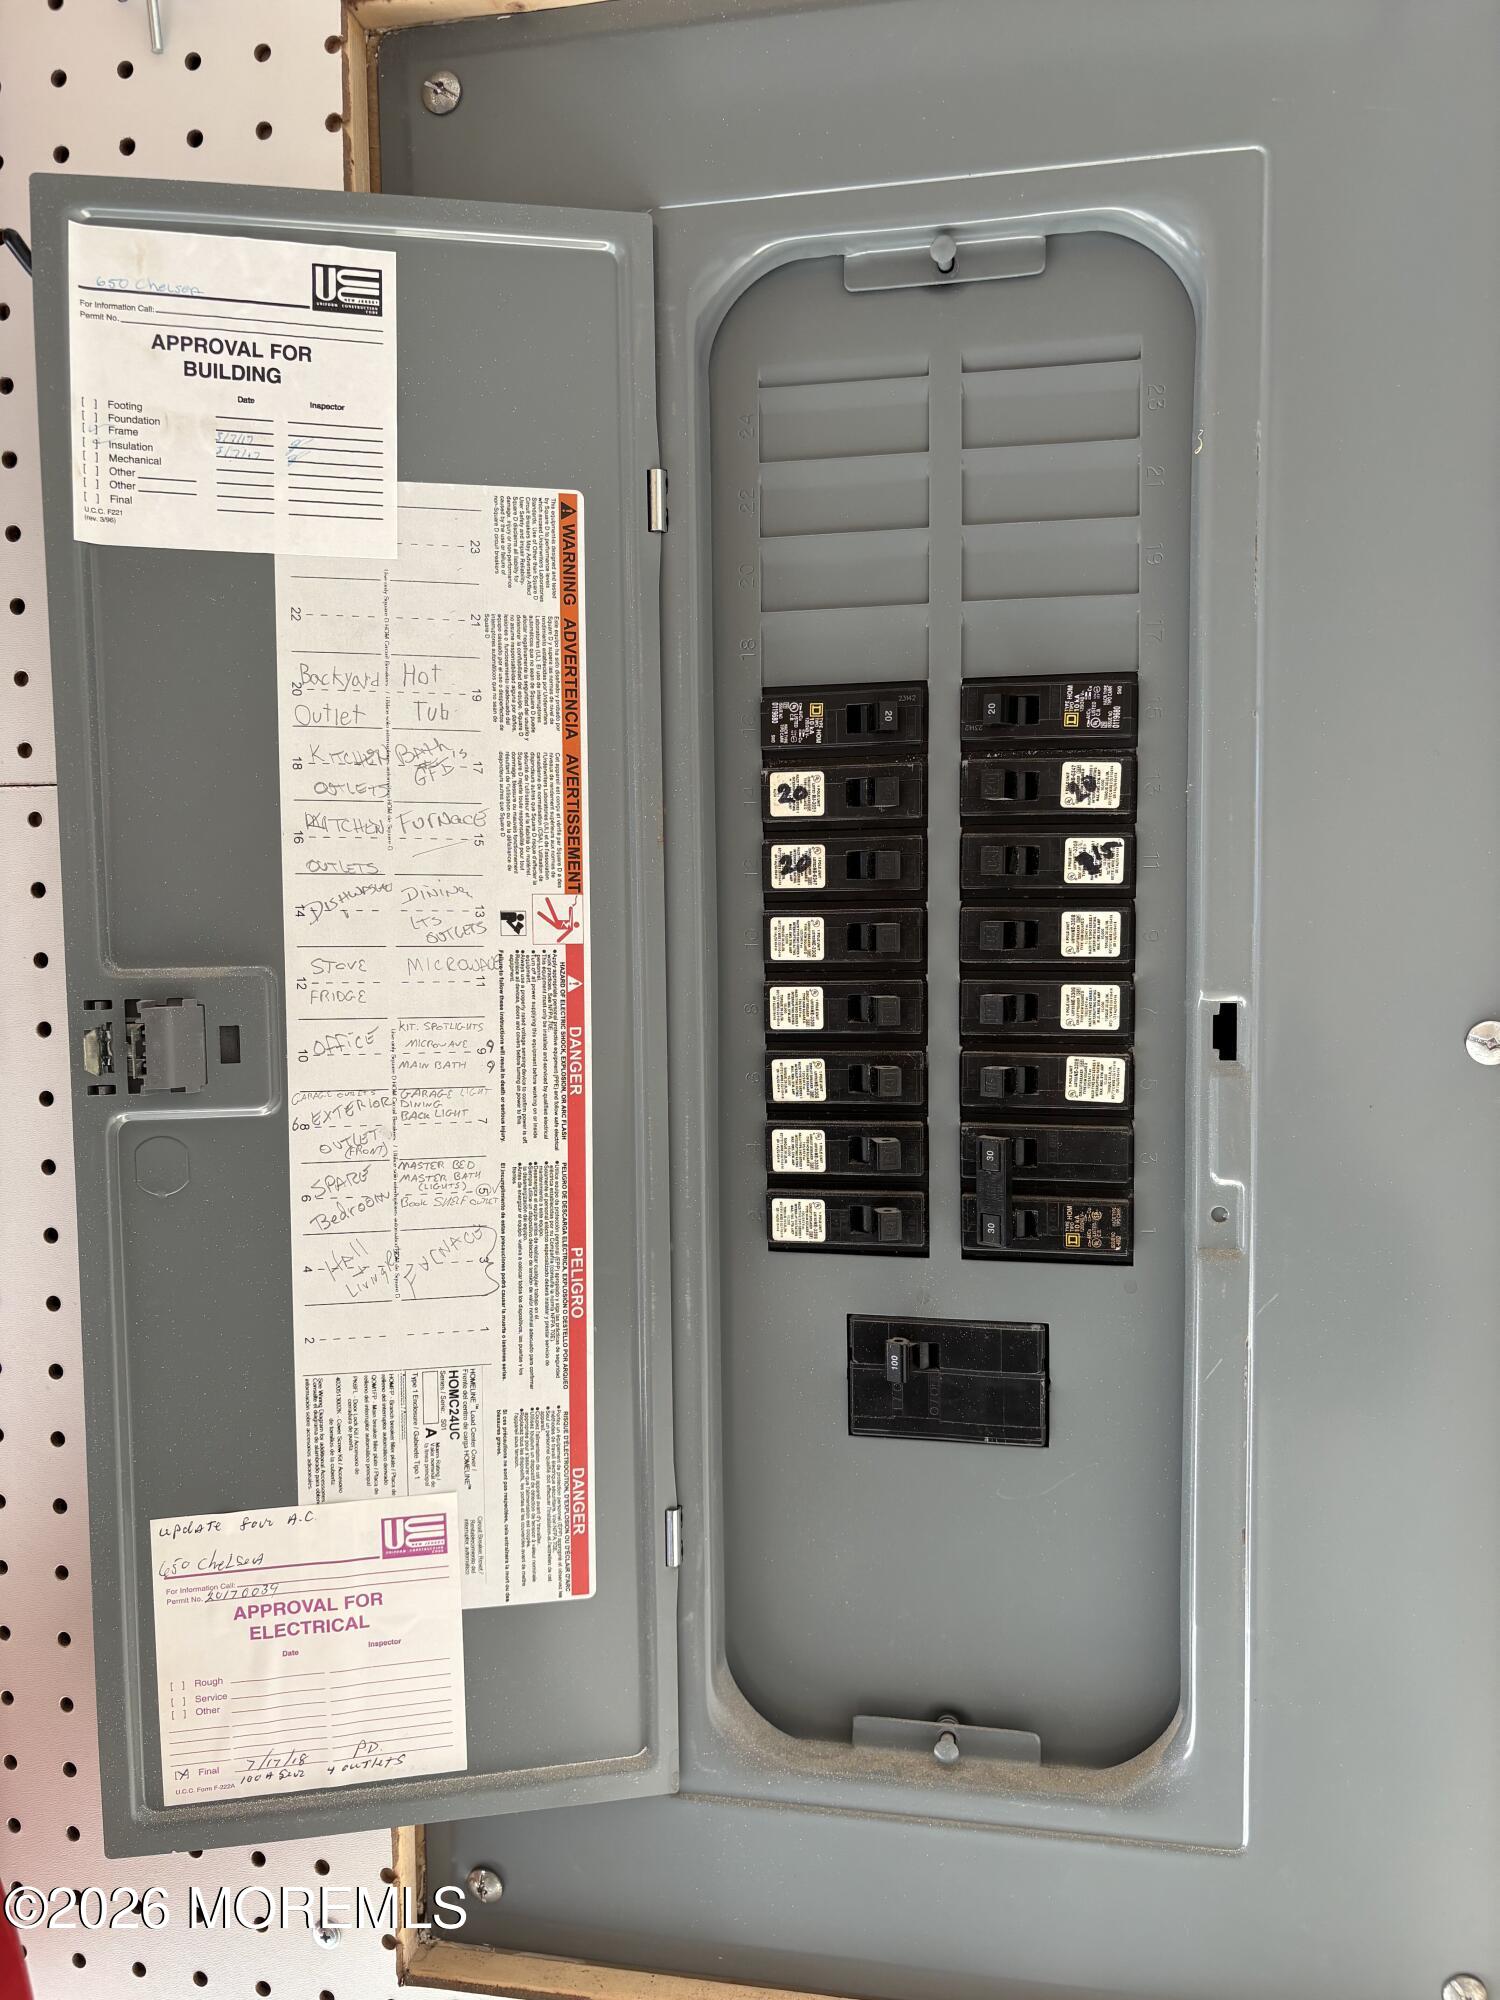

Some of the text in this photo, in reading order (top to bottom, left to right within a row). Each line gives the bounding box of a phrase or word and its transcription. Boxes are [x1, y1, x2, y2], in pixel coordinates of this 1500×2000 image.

[96, 276, 128, 288] 650
[80, 300, 155, 314] For Information Call:
[79, 311, 120, 323] Permit No.
[151, 334, 312, 363] APPROVAL FOR
[183, 361, 282, 385] BUILDING
[237, 396, 255, 405] Date
[1146, 383, 1166, 411] 23
[108, 400, 143, 413] Footing
[309, 402, 345, 412] Inspector
[108, 413, 161, 426] Foundation
[108, 426, 139, 437] Frame
[738, 413, 756, 441] 24
[108, 441, 154, 453] Insulation
[108, 454, 162, 466] Mechanical
[109, 467, 136, 477] Other
[1145, 466, 1166, 489] 21
[109, 480, 136, 491] Other
[109, 494, 133, 505] Final
[738, 487, 756, 514] 22
[84, 507, 123, 517] U.C.C. F221
[84, 514, 99, 524] (rev.
[470, 540, 480, 554] 23
[1145, 541, 1166, 566] 19
[562, 524, 577, 606] WARNING
[738, 564, 757, 589] 20
[290, 607, 301, 621] 22
[470, 614, 480, 626] 21
[1144, 618, 1166, 642] 17
[739, 637, 756, 660] 18
[299, 663, 380, 690] Backyard
[403, 663, 441, 687] Hot
[563, 618, 579, 740] ADVERTENCIA
[291, 681, 302, 696] 20
[472, 688, 482, 702] 19
[294, 703, 367, 726] Outlet
[413, 700, 449, 721] Tub
[987, 703, 996, 715] 20
[884, 710, 893, 722] 20
[292, 756, 303, 770] 18
[473, 762, 483, 774] 17
[565, 754, 581, 894] AVERTISSEMENT
[294, 830, 304, 844] 16
[474, 834, 485, 847] 15
[306, 859, 379, 874] OUTLETS
[295, 905, 305, 918] 14
[475, 905, 485, 918] 13
[310, 958, 368, 975] STOVE
[297, 977, 307, 990] 12
[475, 976, 486, 987] 11
[310, 990, 368, 1005] FRIDGE
[560, 989, 566, 998] OF
[399, 1021, 420, 1031] KIT.
[405, 1039, 468, 1049] MICROWAVE
[298, 1049, 309, 1063] 10
[477, 1047, 487, 1055] 9
[398, 1060, 430, 1070] MAIN
[434, 1061, 467, 1070] BATH
[569, 1026, 582, 1096] DANGER
[400, 1089, 453, 1099] GARAGE
[561, 1094, 567, 1104] OR
[310, 1096, 393, 1126] EXTERIOR
[400, 1100, 443, 1109] DINING
[434, 1109, 470, 1119] LIGHT
[299, 1123, 310, 1131] 8
[319, 1128, 378, 1154] OUTLET
[986, 1150, 994, 1161] 30
[397, 1159, 476, 1171] MASTER BED
[399, 1171, 481, 1183] MASTER BATH
[418, 1181, 467, 1192] (LIGHTS)
[478, 1187, 489, 1195] 5
[301, 1195, 312, 1203] 6
[987, 1222, 995, 1234] 30
[479, 1256, 489, 1264] 3
[570, 1247, 584, 1319] PELIGRO
[304, 1337, 315, 1345] 2
[890, 1354, 899, 1370] 100
[449, 1370, 460, 1440] HOMC24UC
[426, 1428, 437, 1438] A
[572, 1467, 586, 1536] DANGER
[158, 1558, 190, 1578] 650
[179, 1584, 219, 1594] Information
[219, 1582, 236, 1590] Call:
[166, 1595, 203, 1606] Permit No.
[233, 1591, 384, 1621] APPROVAL FOR
[249, 1615, 370, 1641] ELECTRICAL
[368, 1638, 402, 1648] Inspector
[282, 1648, 299, 1658] Date
[194, 1677, 224, 1689] Rough
[195, 1692, 228, 1704] Service
[195, 1706, 221, 1716] Other
[245, 1748, 309, 1772] 7/17/18
[198, 1766, 220, 1777] Final
[175, 1783, 236, 1797] U.C.C. Form F-222A
